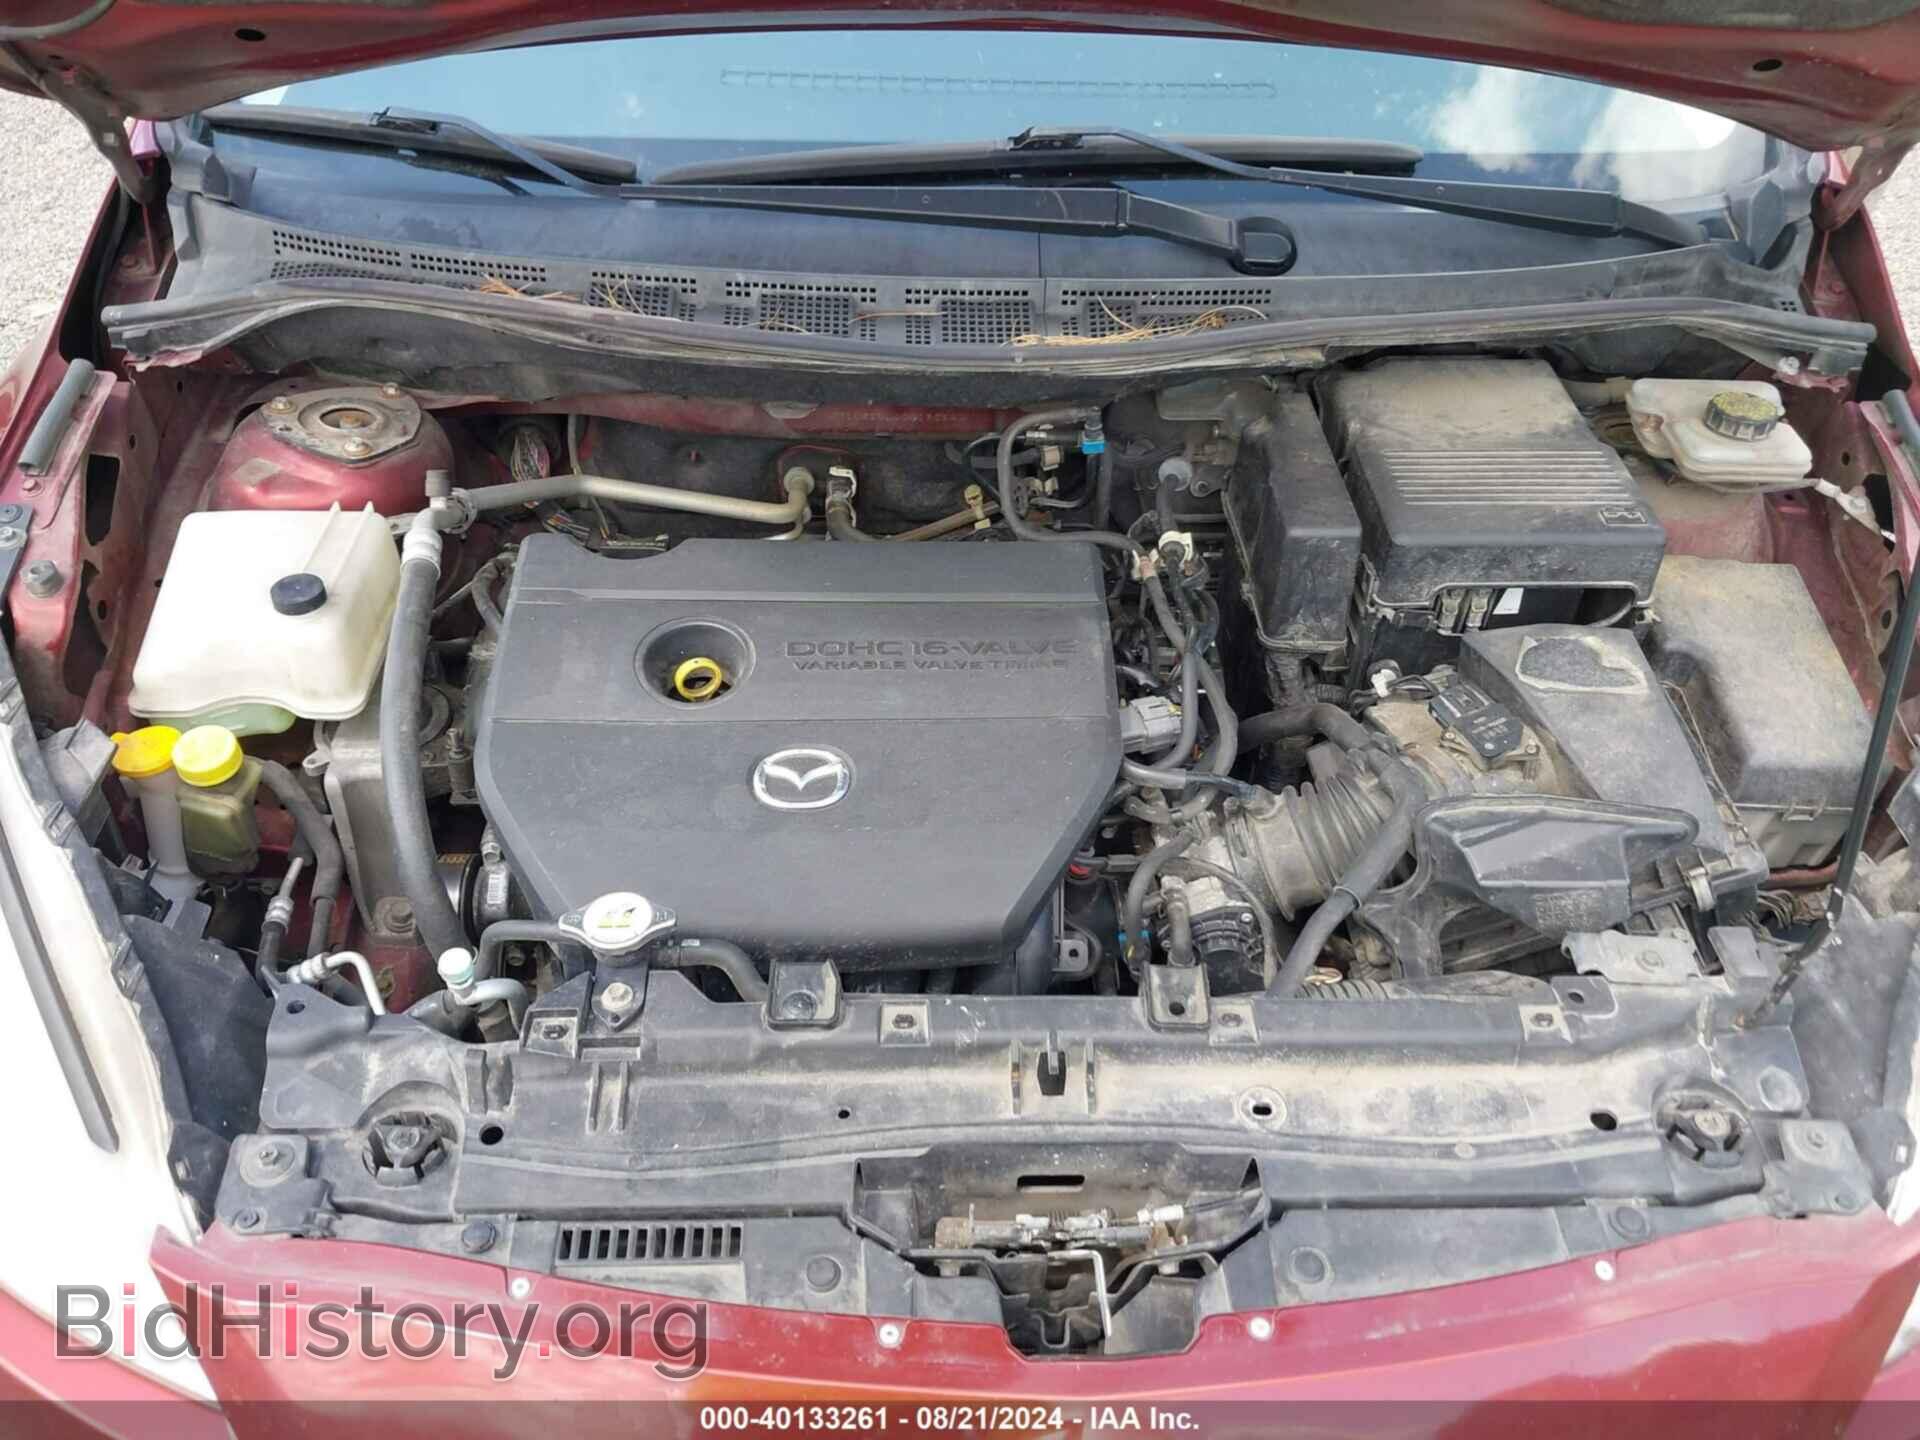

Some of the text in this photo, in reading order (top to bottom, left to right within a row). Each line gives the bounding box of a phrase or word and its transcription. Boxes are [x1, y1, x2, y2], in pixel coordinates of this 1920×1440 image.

[785, 639, 1079, 657] DOHC 16-VALVE
[793, 659, 906, 672] VARIABLE
[913, 659, 984, 671] VALVE
